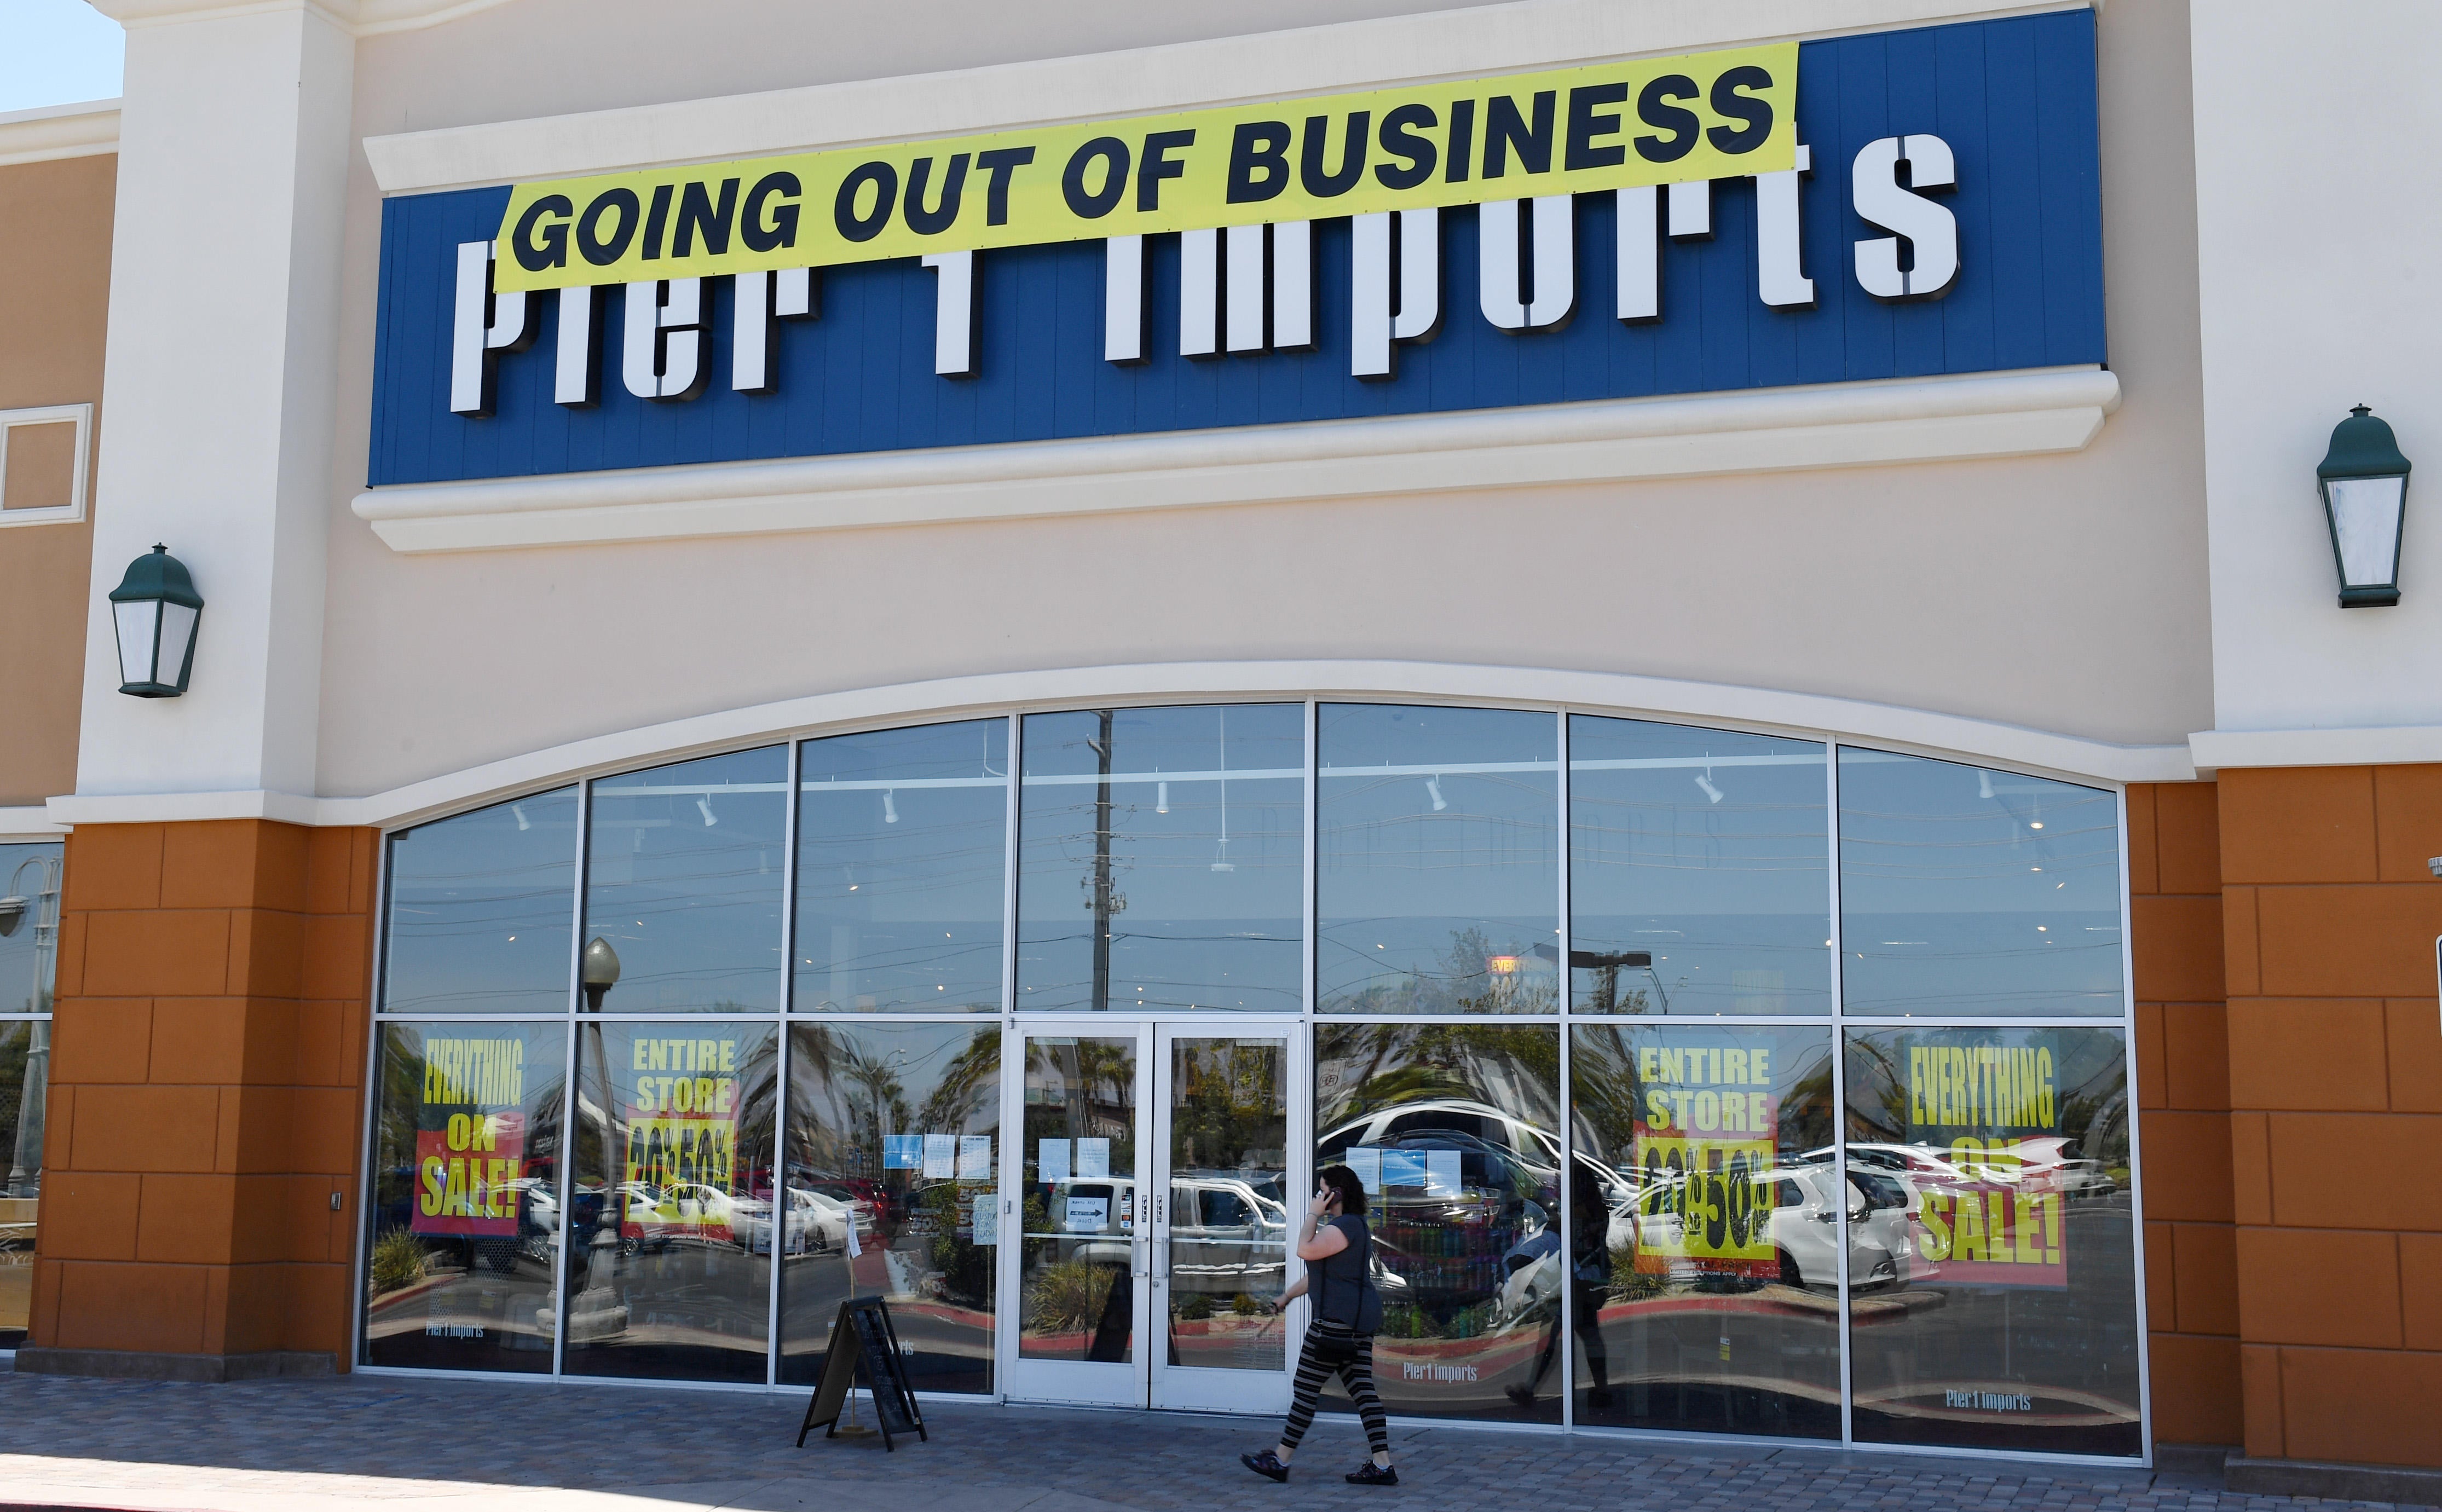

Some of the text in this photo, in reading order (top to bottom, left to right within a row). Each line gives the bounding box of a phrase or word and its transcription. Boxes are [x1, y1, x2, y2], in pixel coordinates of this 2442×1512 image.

[512, 66, 1773, 272] GOING OUT OF BUSINESS
[424, 1038, 523, 1106] EVERYTHING
[633, 1039, 735, 1071] ENTIRE
[1640, 1047, 1770, 1084] ENTIRE
[637, 1076, 731, 1113] STORE
[1646, 1089, 1769, 1132] STORE
[1910, 1047, 2054, 1129] EVERYTHING
[447, 1113, 496, 1151] ON
[1950, 1136, 2022, 1183] ON
[420, 1156, 519, 1218] SALE!
[1707, 1149, 1766, 1249] 50%
[1918, 1188, 2060, 1265] SALE!
